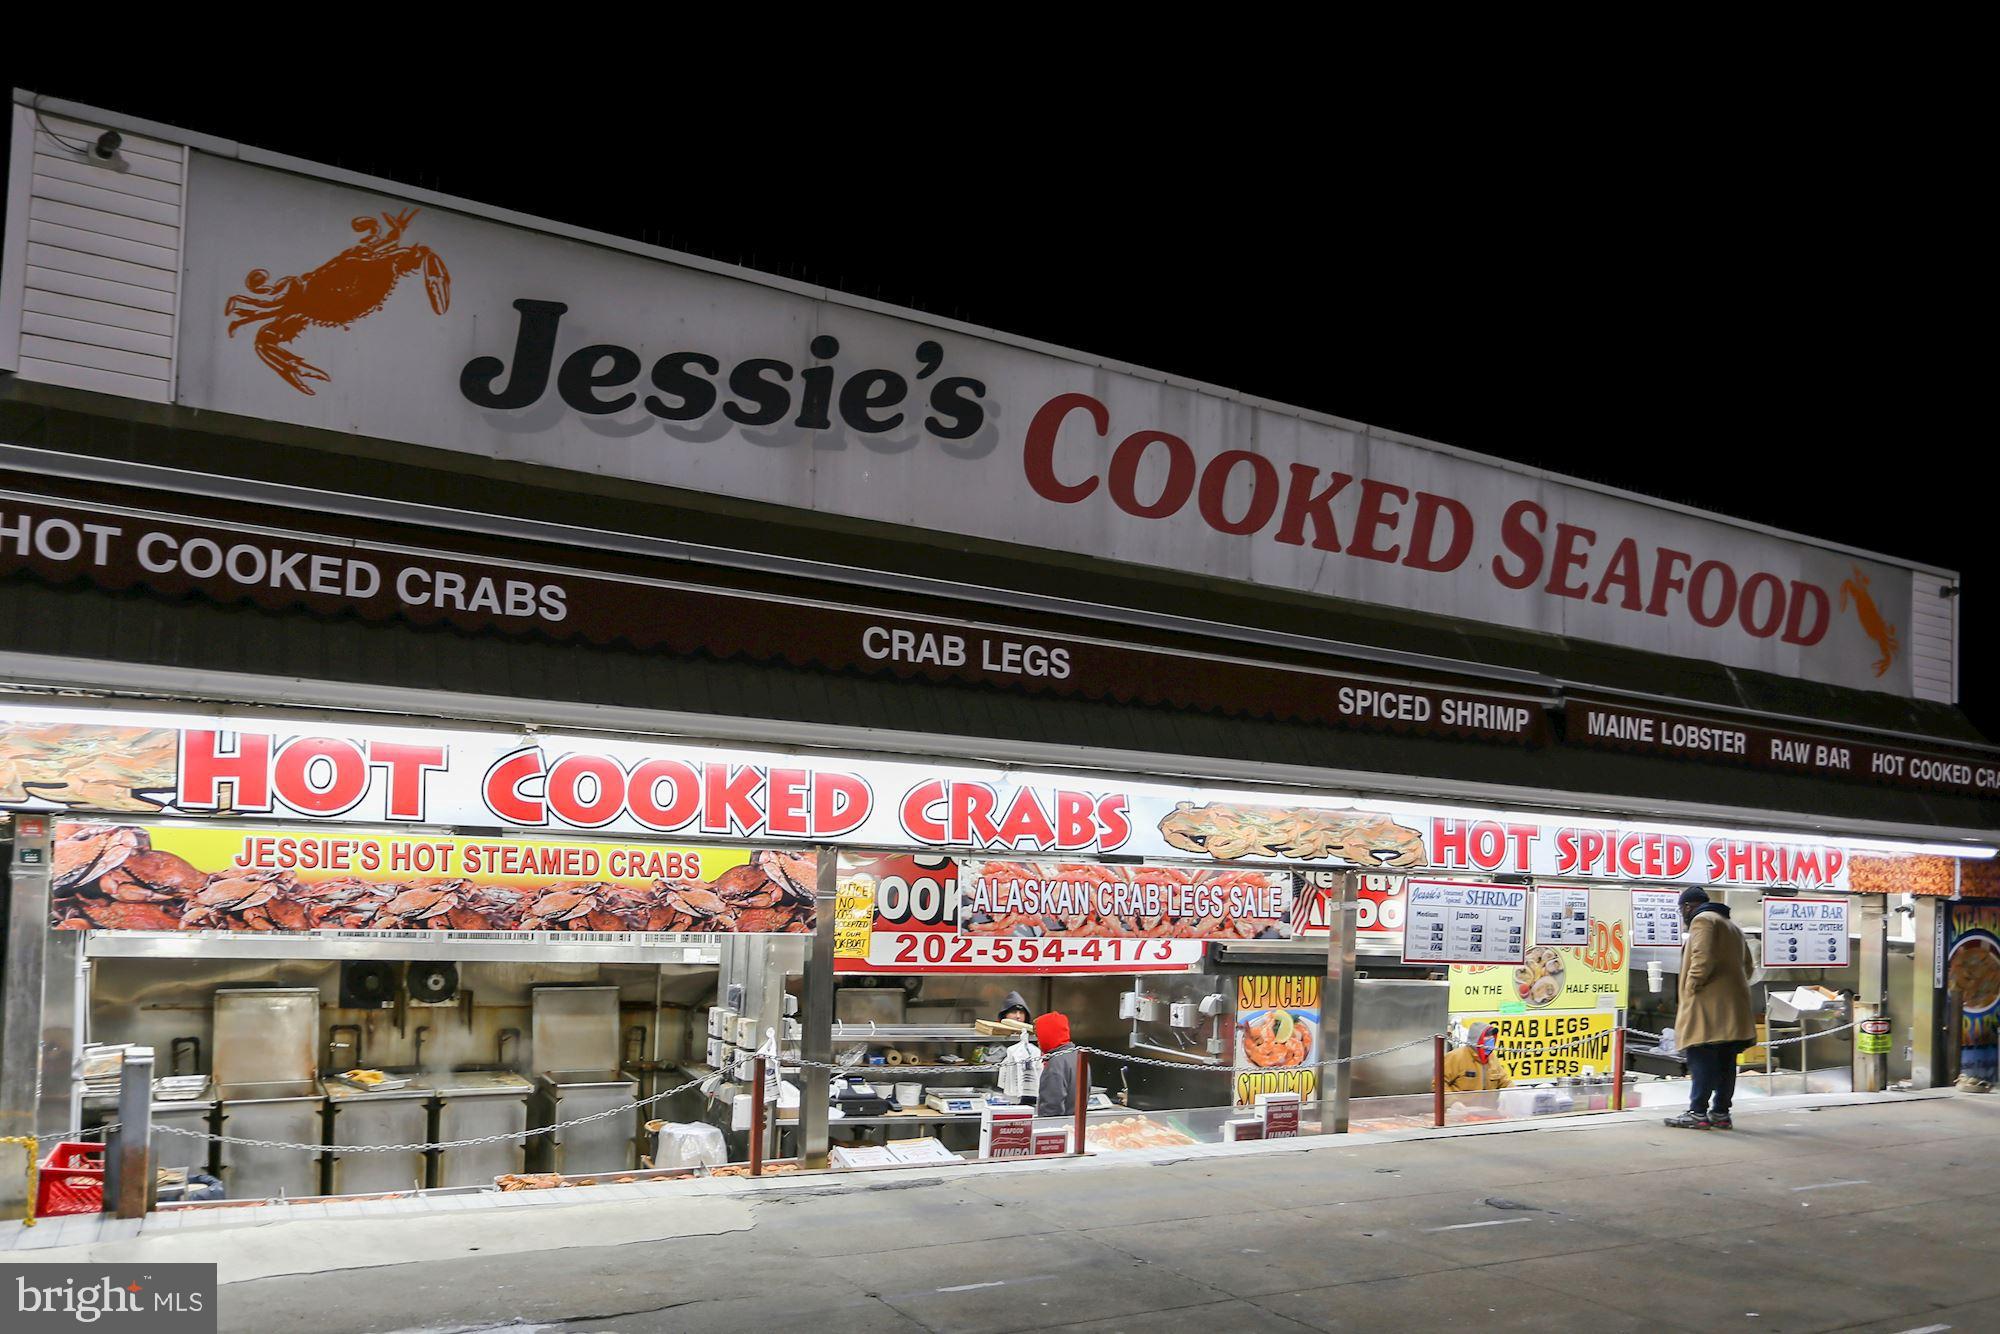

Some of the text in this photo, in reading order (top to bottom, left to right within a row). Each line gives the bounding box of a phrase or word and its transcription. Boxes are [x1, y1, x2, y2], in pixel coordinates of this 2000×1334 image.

[460, 298, 990, 442] Jessie's
[1023, 393, 1832, 648] COOKED SEAFOOD
[0, 512, 568, 622] HOT COOKED CRABS
[862, 626, 1071, 680] CRAB LEGS
[1338, 686, 1530, 733] SPICED SHRIMP
[1587, 711, 1747, 755] MAINE LOBSTER
[1770, 738, 1850, 770] RAW BAR
[1872, 752, 1906, 776] HOT
[1910, 758, 1972, 785] COOKED
[178, 729, 1131, 853] HOT COOKED CRABS
[235, 837, 701, 879] JESSIE'S HOT STEAMED CRABS
[1430, 816, 1844, 889] HOT SPICED SHRIMP
[838, 897, 855, 910] NO
[877, 875, 958, 922] OOK
[972, 878, 1090, 915] ALASKAN
[1097, 882, 1161, 917] CRAB
[1167, 884, 1223, 918] LEGS
[1229, 886, 1283, 919] SALE
[1466, 890, 1524, 908] SHRIMP
[1791, 903, 1818, 919] RAW
[1821, 904, 1843, 919] BAR
[835, 920, 869, 929] CCEPTED
[1456, 911, 1480, 921] Jumbo
[1498, 915, 1514, 923] Large
[1780, 922, 1804, 931] CLAMS
[1818, 923, 1844, 932] OYSTERS
[894, 934, 1173, 964] 202-554-4173
[1240, 976, 1318, 1009] SPICED
[1464, 983, 1620, 995] ON THE HALF SHELL
[1545, 1017, 1590, 1038] LEGS
[1549, 1032, 1611, 1061] SHRIMP
[1507, 1061, 1580, 1077] YSTERS
